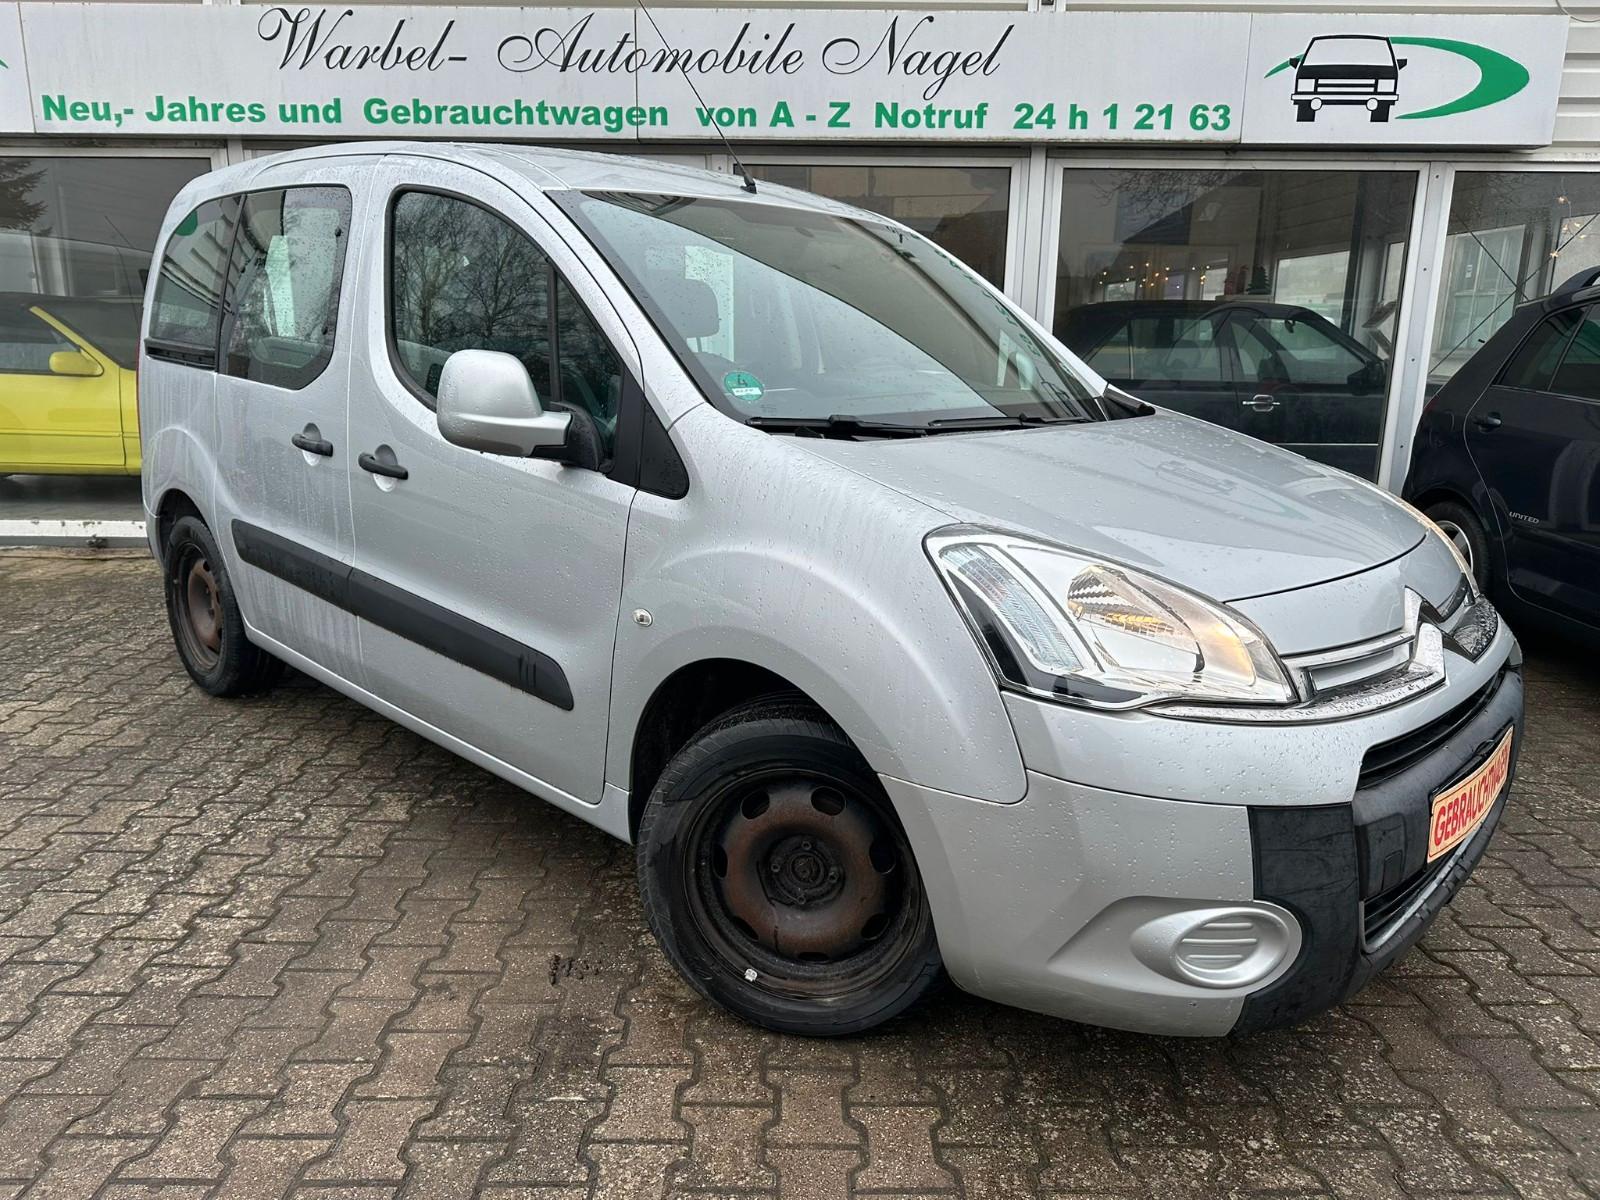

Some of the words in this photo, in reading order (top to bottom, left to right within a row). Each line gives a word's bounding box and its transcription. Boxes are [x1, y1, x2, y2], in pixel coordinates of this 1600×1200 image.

[258, 8, 467, 71] Warbel-
[497, 13, 804, 75] Automobile
[822, 15, 1015, 101] Nagel
[42, 95, 134, 127] Neu,-
[145, 96, 267, 124] Jahres
[278, 97, 343, 124] und
[363, 97, 669, 134] Gebrauchtwagen
[696, 106, 758, 129] von
[769, 101, 795, 128] A
[805, 113, 817, 122] -
[827, 102, 852, 128] Z
[875, 102, 989, 130] Notruf
[1013, 103, 1057, 130] 24
[1069, 104, 1089, 130] h
[1104, 104, 1120, 130] 1
[1134, 103, 1174, 130] 21
[1189, 104, 1232, 131] 63
[1509, 511, 1540, 524] UNITED
